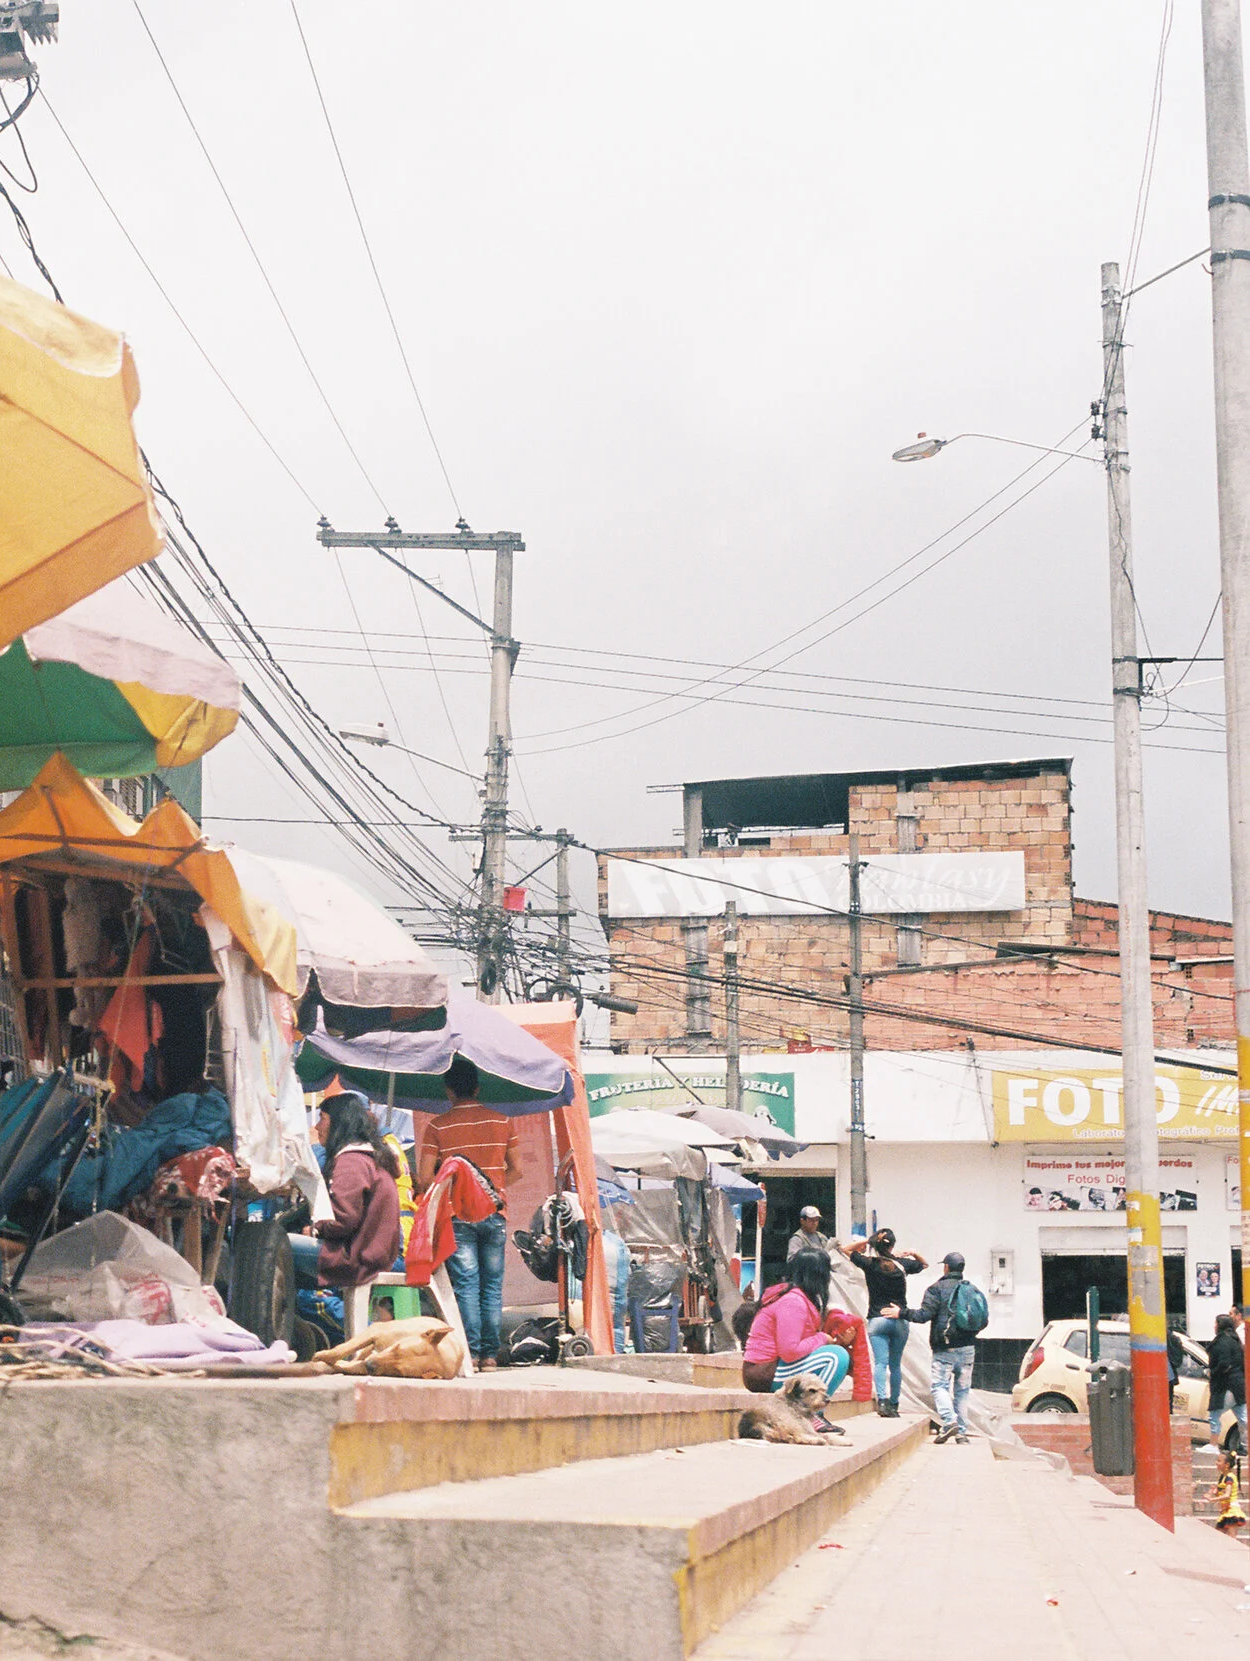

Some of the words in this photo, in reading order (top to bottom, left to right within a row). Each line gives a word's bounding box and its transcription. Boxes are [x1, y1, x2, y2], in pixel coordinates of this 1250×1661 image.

[692, 1075, 789, 1099] HELDERÍA
[1215, 1126, 1239, 1137] Prof
[1075, 1159, 1092, 1169] tus
[1067, 1174, 1101, 1185] Fotos
[1105, 1174, 1126, 1186] Dig
